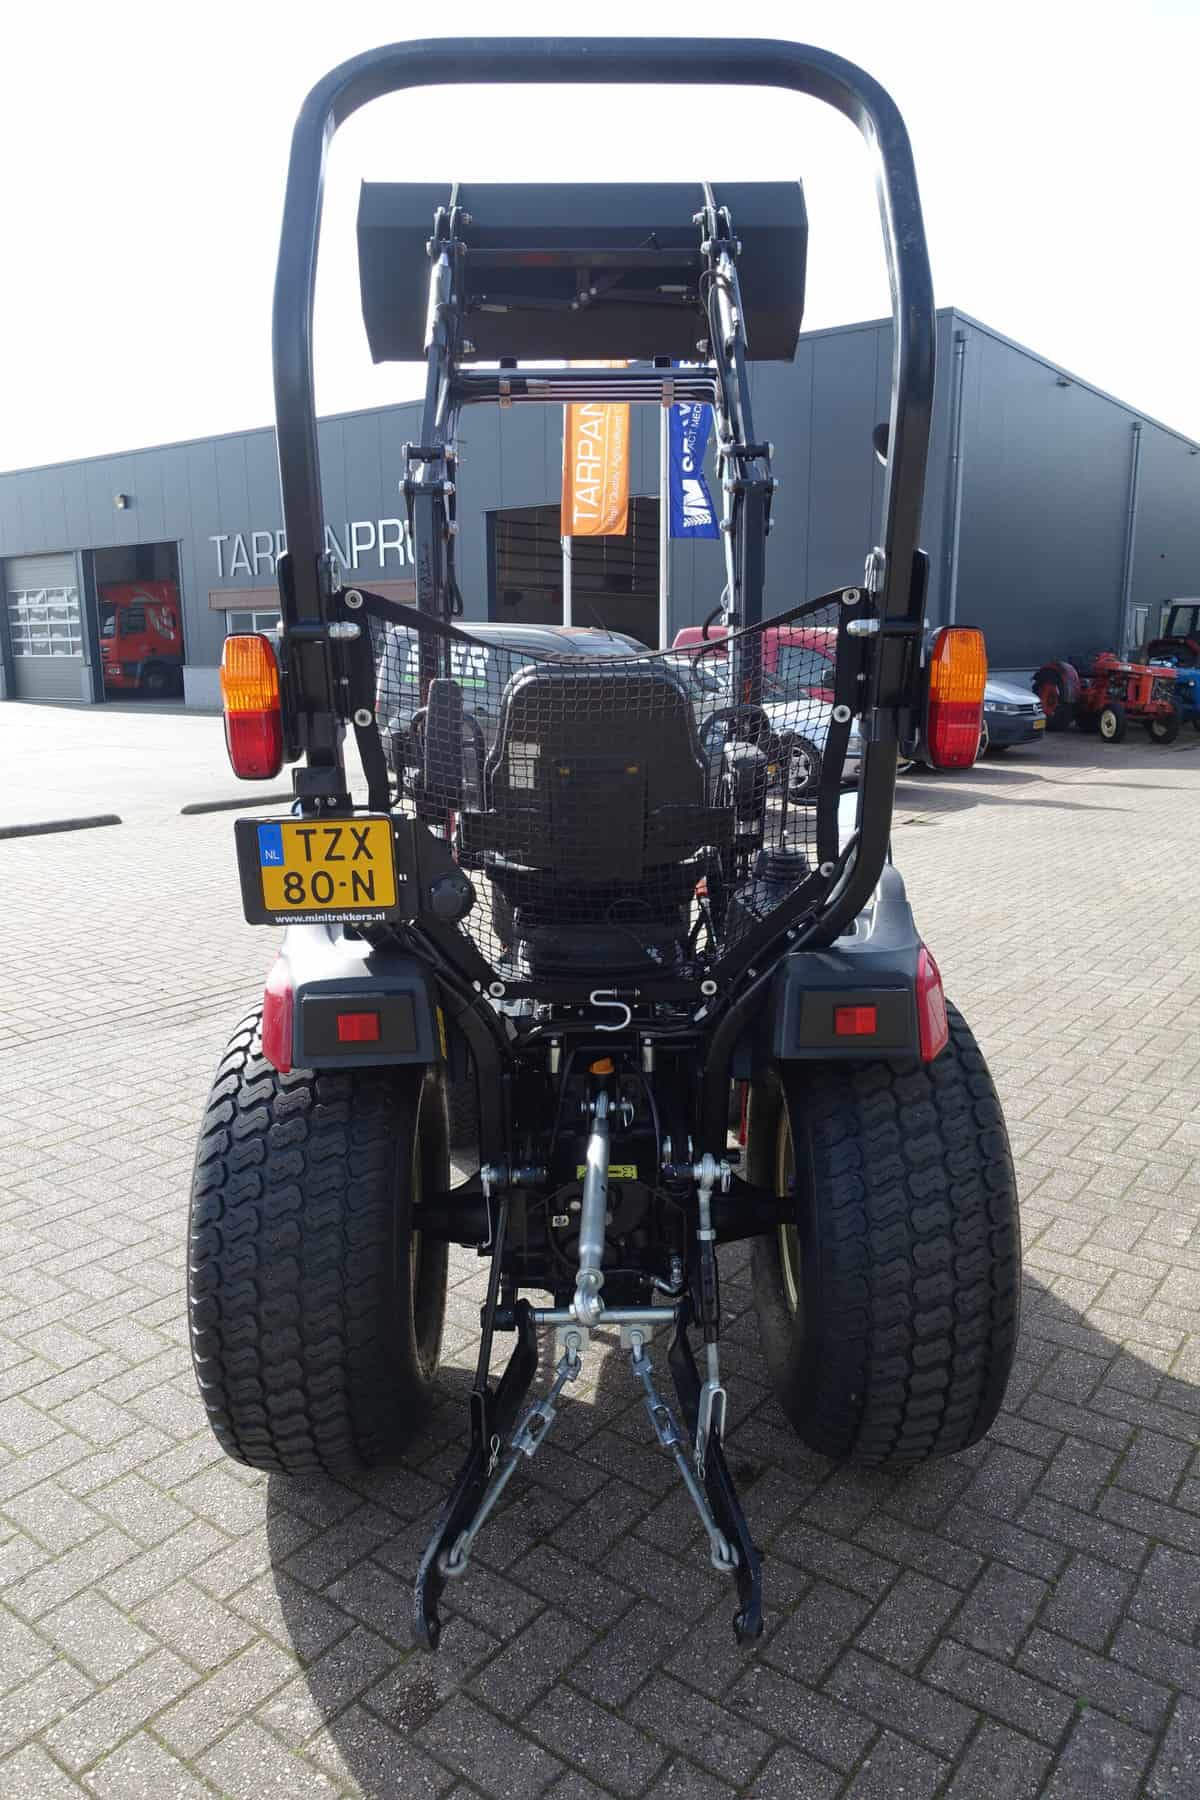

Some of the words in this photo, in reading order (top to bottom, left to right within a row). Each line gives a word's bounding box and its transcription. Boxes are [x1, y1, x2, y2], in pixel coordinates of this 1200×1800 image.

[264, 849, 281, 860] NL
[295, 826, 374, 862] TZX
[282, 869, 376, 905] 80-N
[275, 911, 386, 923] www.minitrekkers.nl
